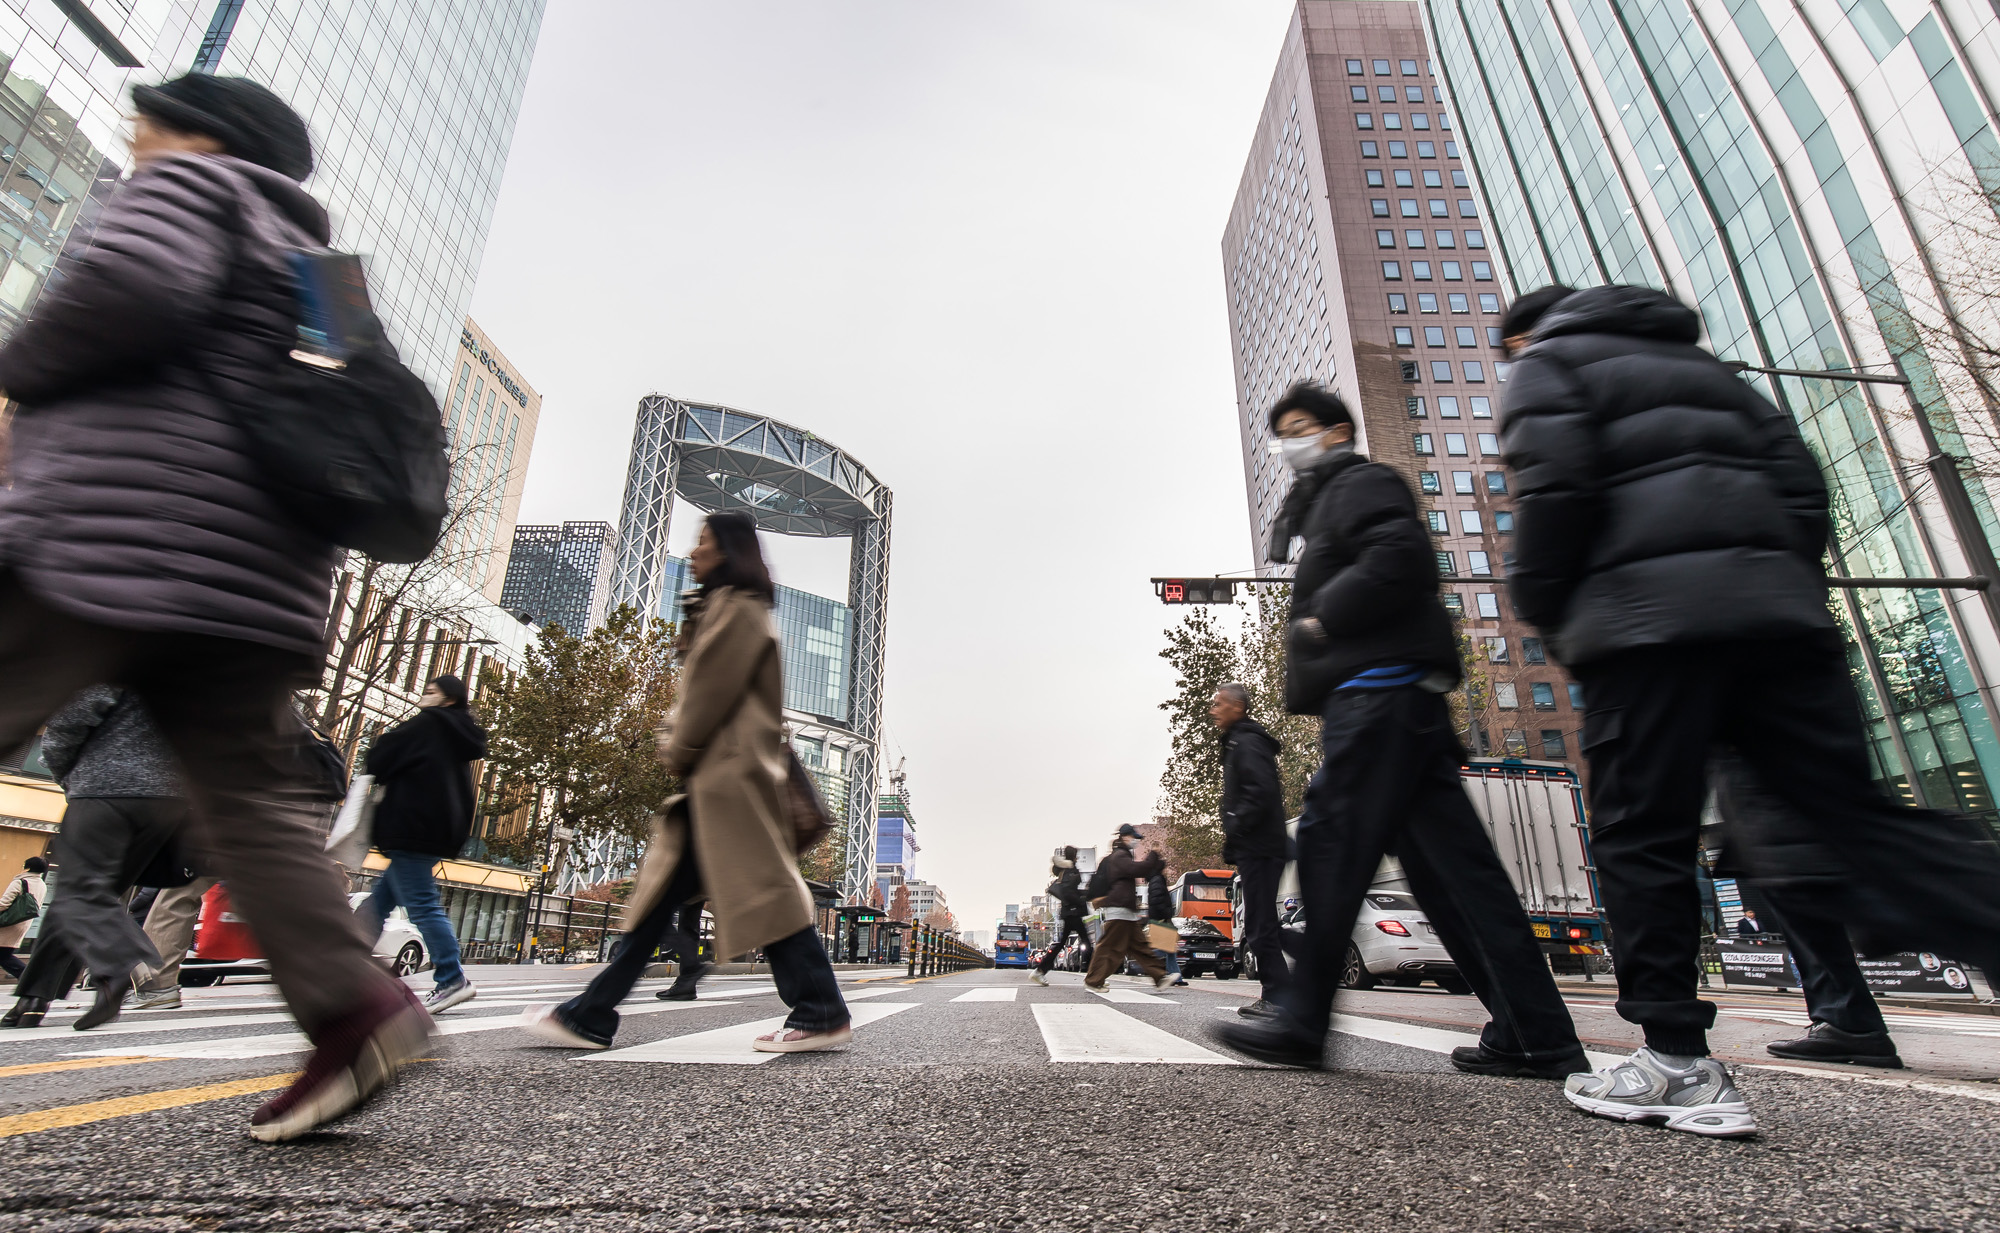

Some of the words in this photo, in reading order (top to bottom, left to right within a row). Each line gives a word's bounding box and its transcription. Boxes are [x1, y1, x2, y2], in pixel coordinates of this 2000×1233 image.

[480, 350, 528, 408] SC제일은행
[1739, 954, 1750, 962] JOB
[1751, 954, 1780, 963] CONCERT
[1620, 1069, 1646, 1090] N
